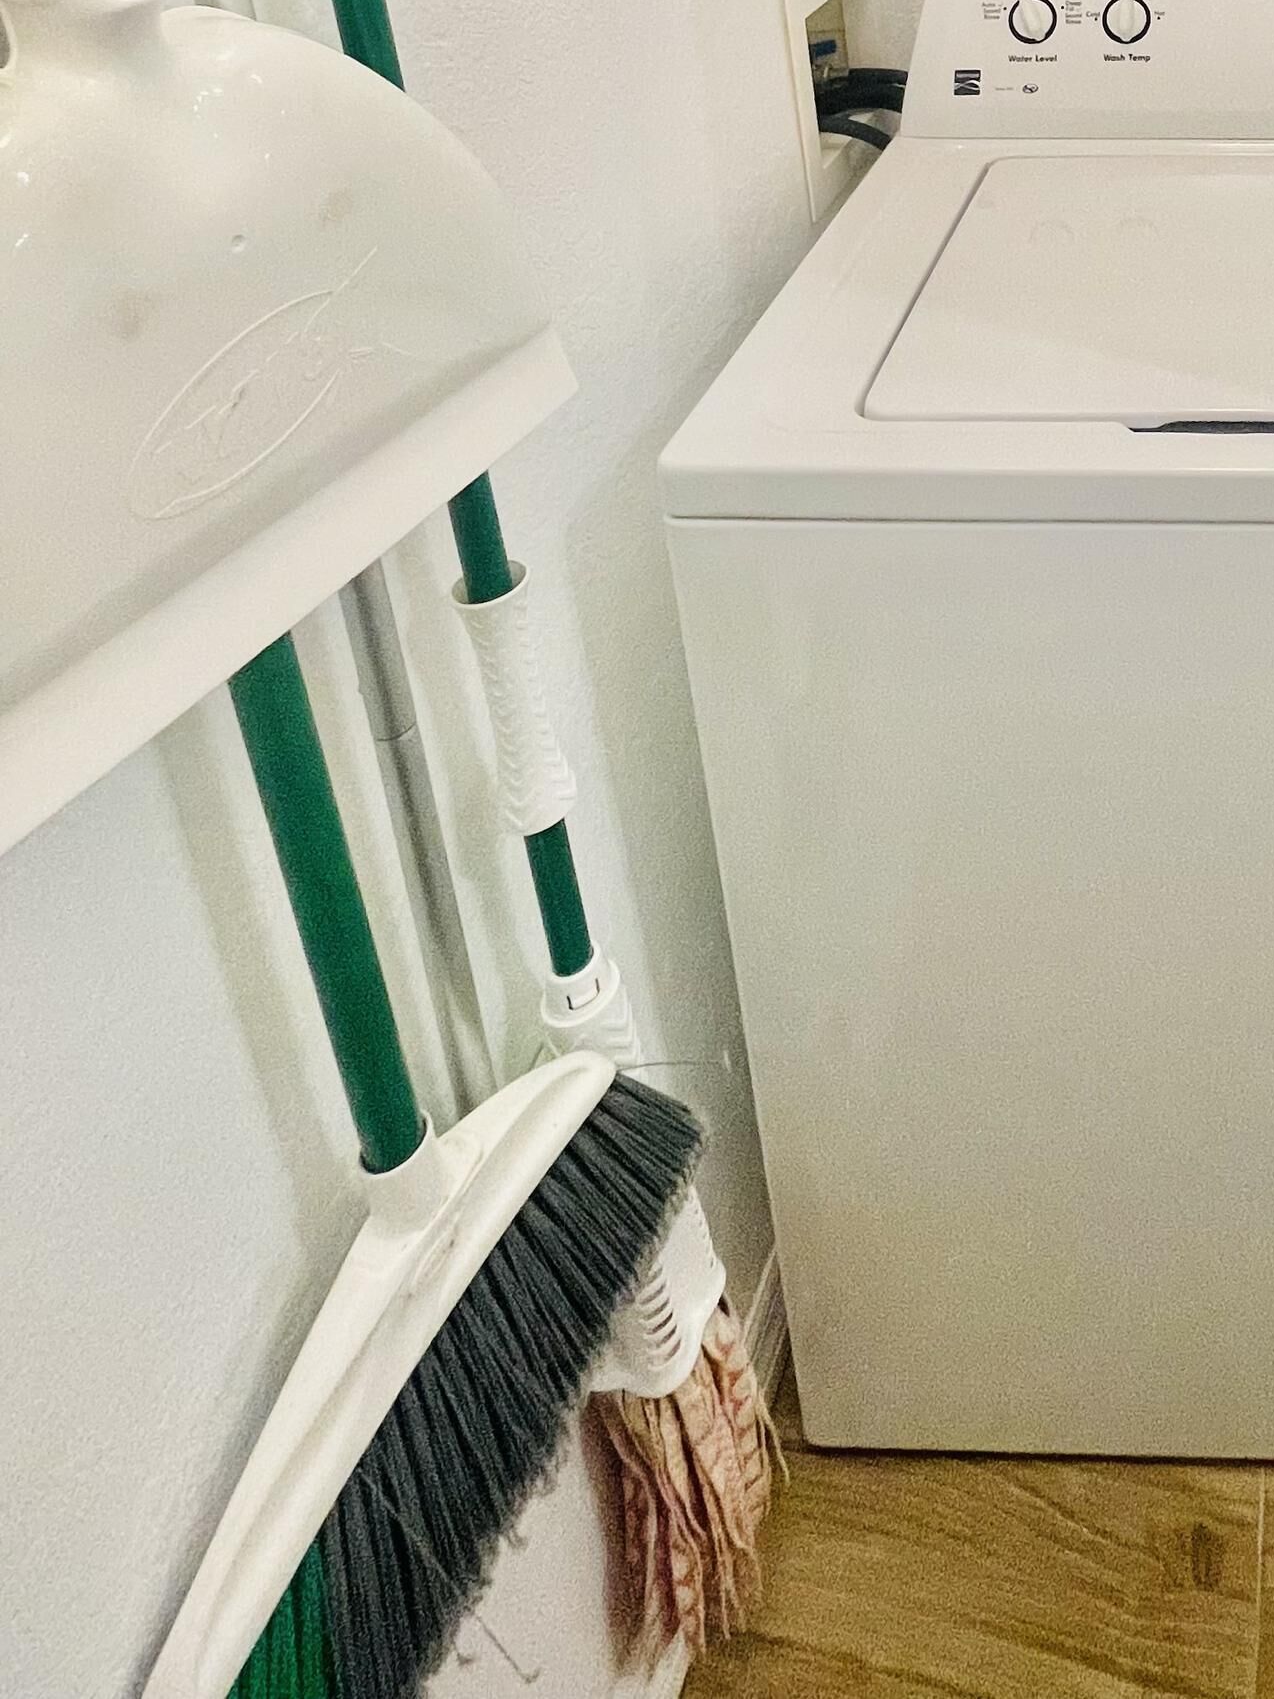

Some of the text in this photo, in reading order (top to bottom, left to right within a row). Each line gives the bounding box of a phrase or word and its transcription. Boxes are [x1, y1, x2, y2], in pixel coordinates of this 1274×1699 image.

[1035, 54, 1058, 62] Level
[1103, 53, 1151, 63] Wash Temp
